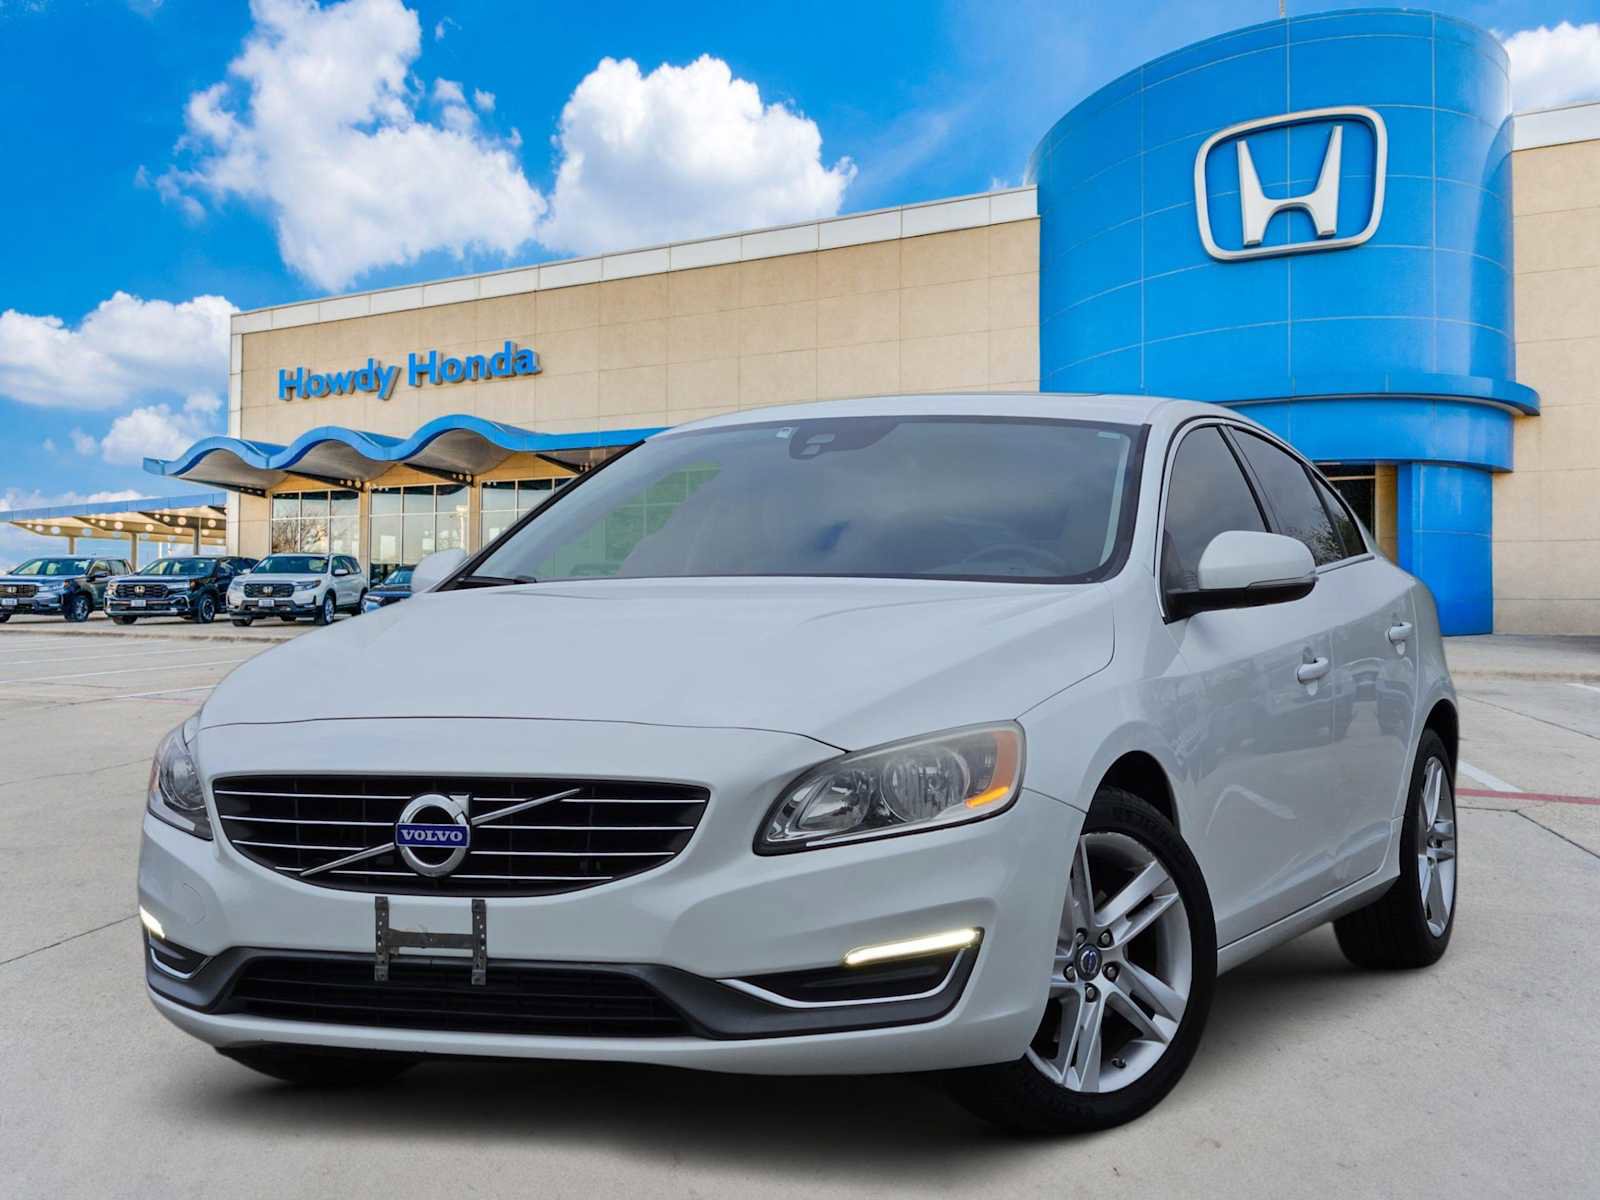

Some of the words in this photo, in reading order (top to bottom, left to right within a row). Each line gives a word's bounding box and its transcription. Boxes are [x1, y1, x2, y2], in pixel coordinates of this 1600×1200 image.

[278, 358, 399, 401] Howdy
[407, 340, 541, 388] Honda
[400, 829, 463, 842] VOLVO
